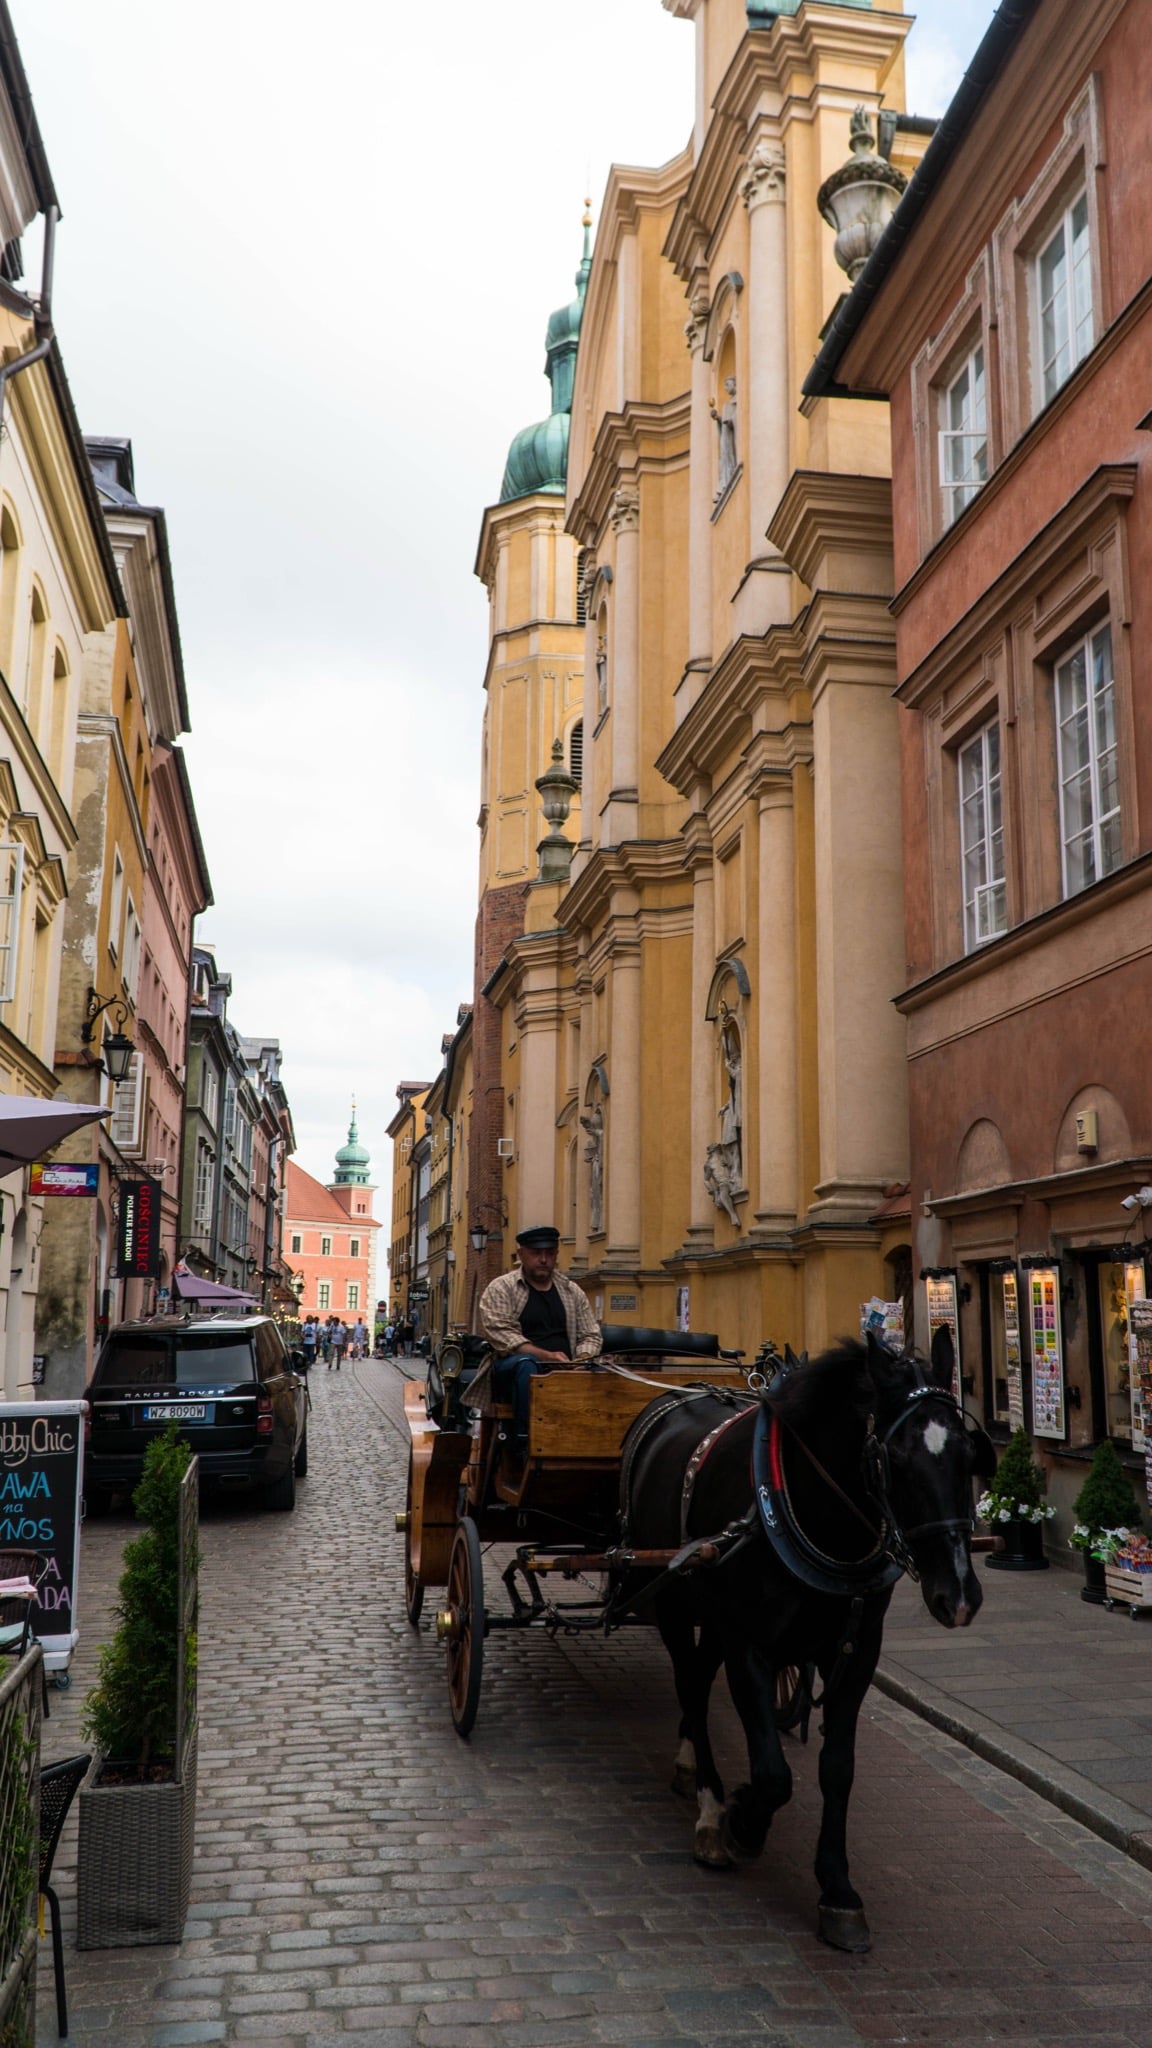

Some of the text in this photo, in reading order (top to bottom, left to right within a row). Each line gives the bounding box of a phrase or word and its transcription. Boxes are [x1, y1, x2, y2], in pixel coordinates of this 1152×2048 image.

[125, 1195, 134, 1261] POLSKIE PIEROGI
[178, 1389, 225, 1397] ROVER
[150, 1405, 204, 1418] WZ 8090W
[31, 1418, 76, 1452] Chic
[0, 1471, 52, 1499] AWA
[3, 1503, 24, 1513] na
